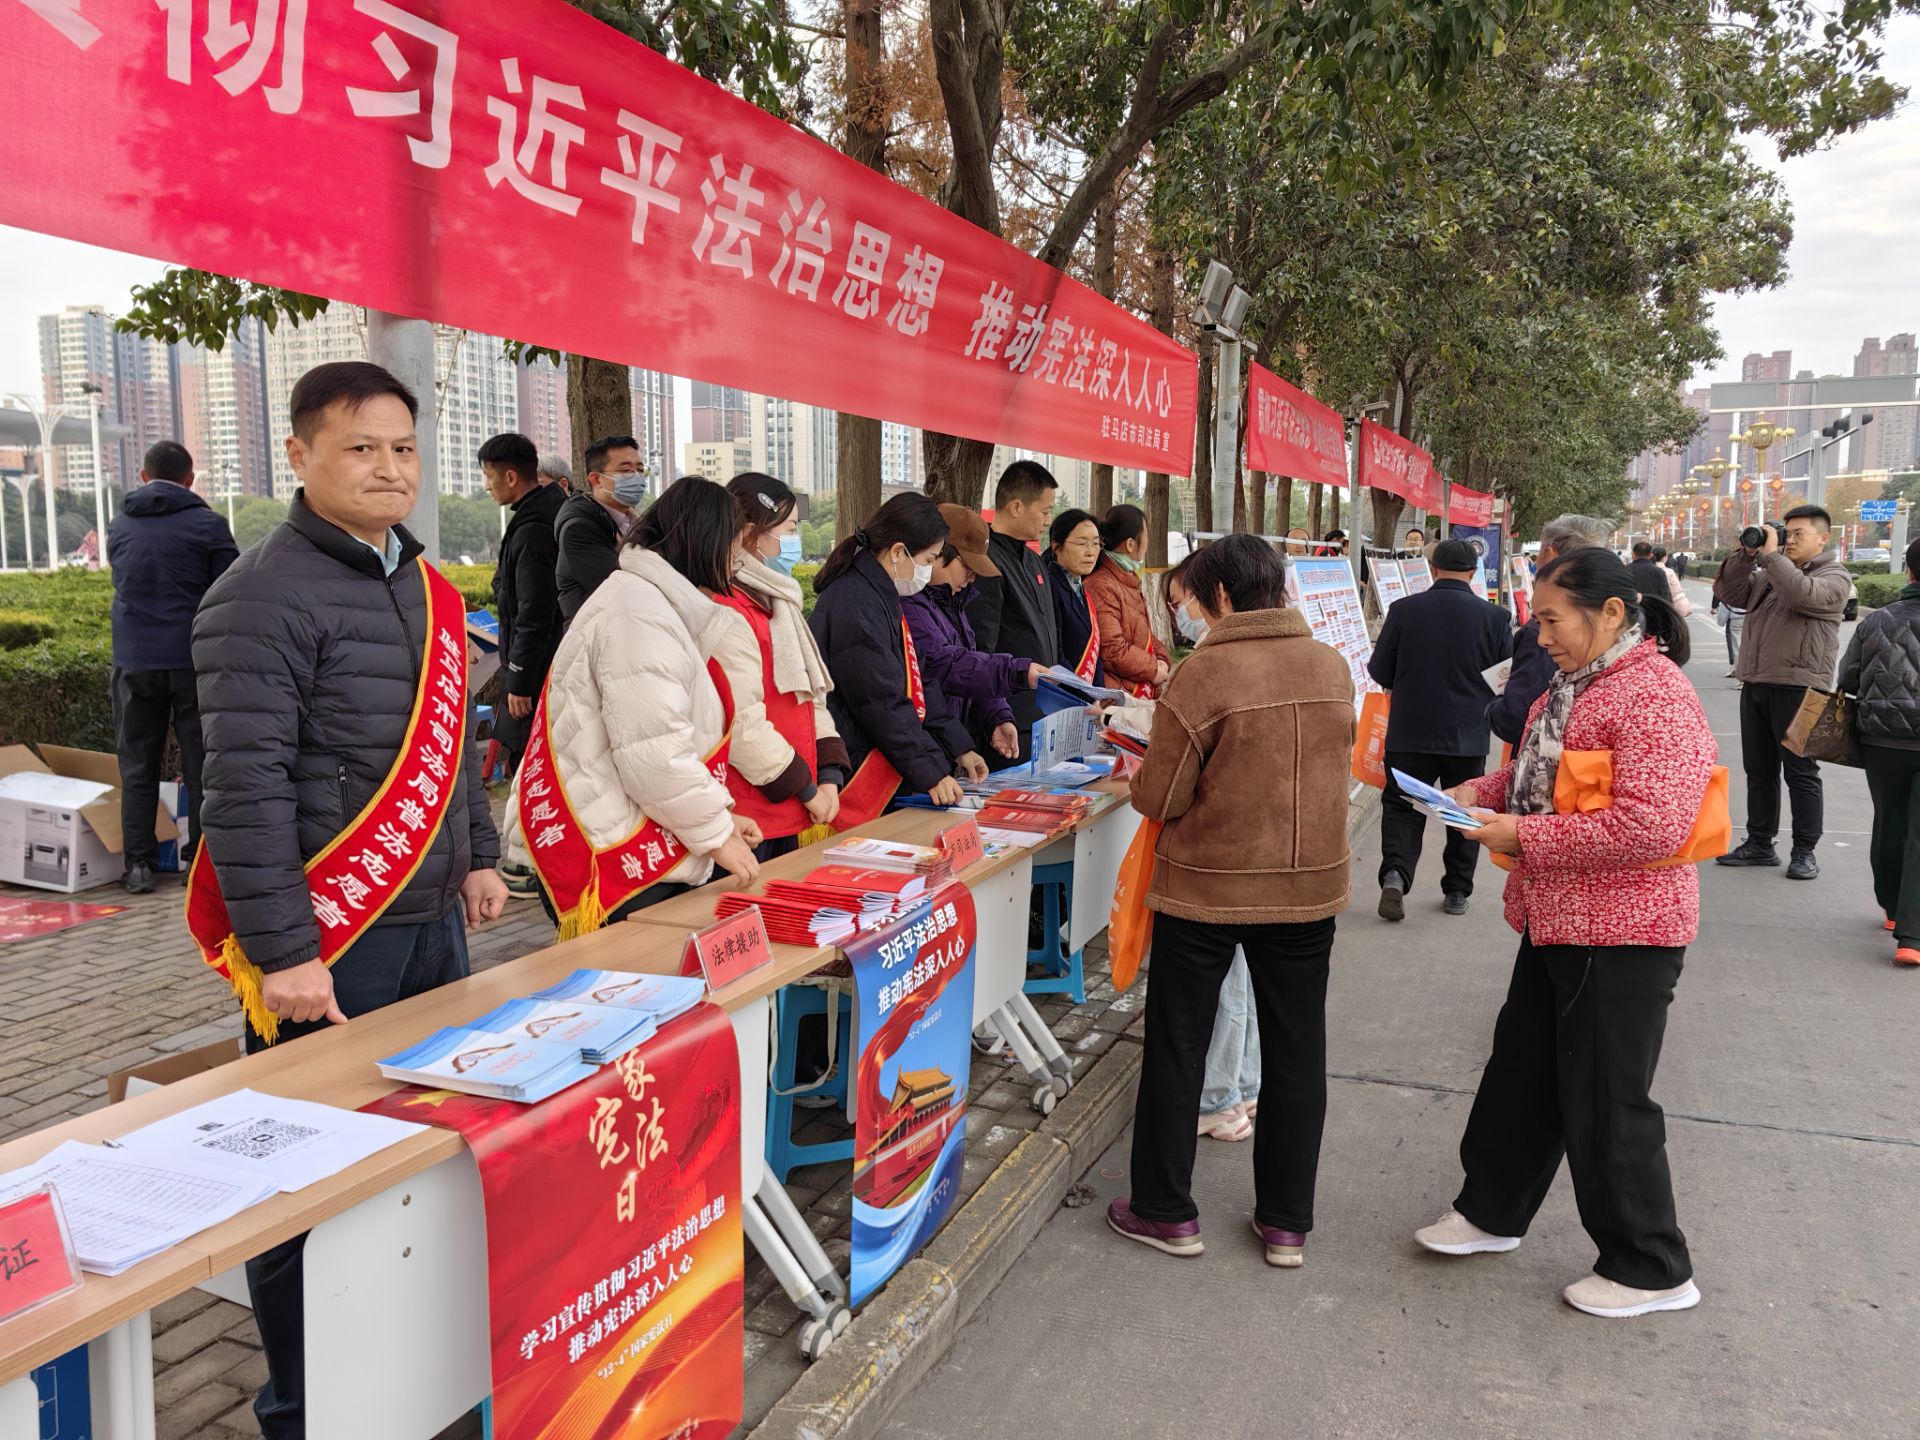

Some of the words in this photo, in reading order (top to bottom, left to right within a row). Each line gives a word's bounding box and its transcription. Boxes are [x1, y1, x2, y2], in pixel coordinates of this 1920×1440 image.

[20, 0, 945, 337] 彻习近平法治思想
[964, 279, 1172, 418] 推动宪法深入人心
[711, 926, 761, 967] 法律援助
[877, 902, 959, 970] 习近平法治思想
[877, 934, 966, 1016] 推动宪法深入人心
[616, 1172, 639, 1223] 日
[519, 1194, 727, 1361] 学习宣传贯彻习近平法治思想
[567, 1252, 694, 1365] 推动宪法深入人心
